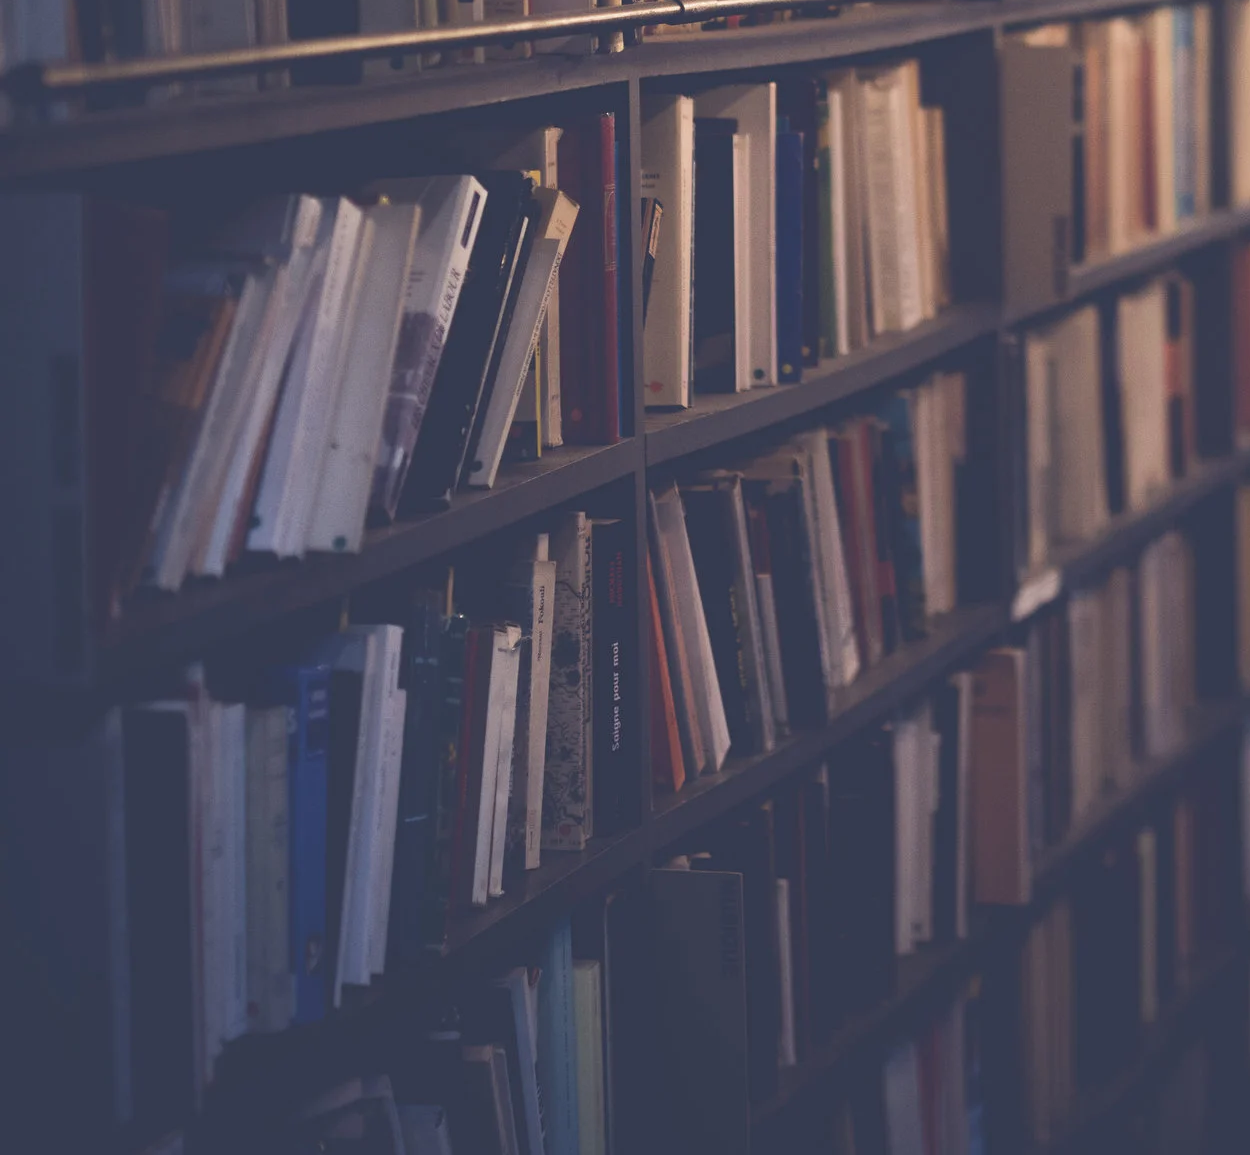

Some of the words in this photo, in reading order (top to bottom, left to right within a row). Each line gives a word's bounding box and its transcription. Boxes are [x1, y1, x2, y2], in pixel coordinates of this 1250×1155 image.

[439, 267, 461, 320] LABOUR
[612, 641, 620, 666] moi
[612, 672, 621, 702] pour
[612, 706, 622, 752] Saigne
